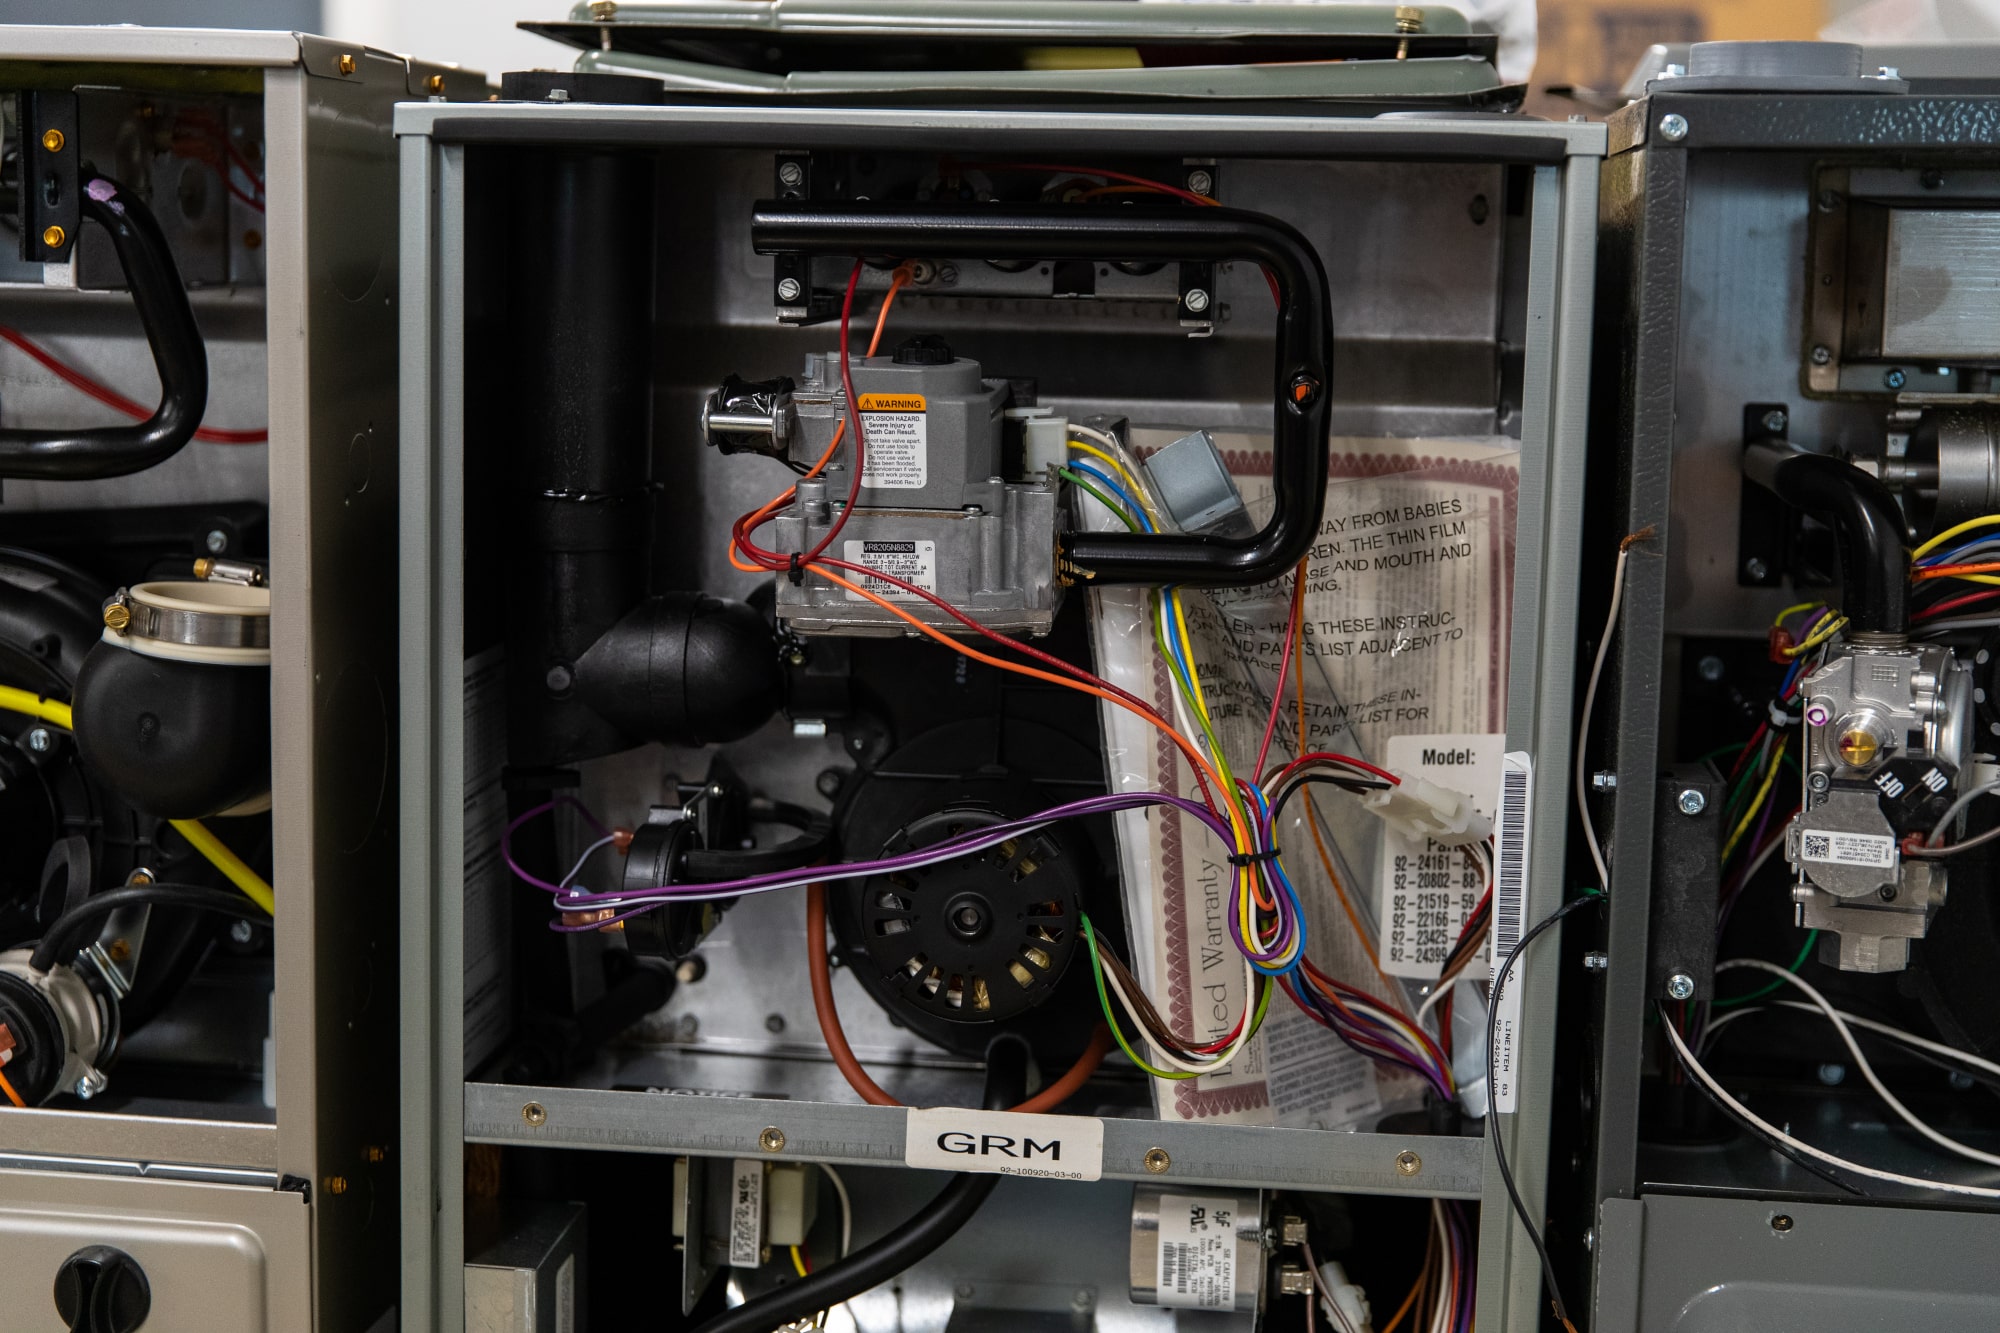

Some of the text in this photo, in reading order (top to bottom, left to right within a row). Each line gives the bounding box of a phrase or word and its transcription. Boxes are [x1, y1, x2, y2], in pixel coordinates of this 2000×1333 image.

[876, 400, 921, 408] WARNING
[1352, 510, 1400, 529] FROM
[1403, 499, 1462, 520] BABIES
[1350, 534, 1383, 552] THE
[1386, 528, 1425, 546] THIN
[1430, 521, 1466, 539] FILM
[1284, 566, 1330, 586] NSE
[1333, 560, 1369, 573] AND
[1374, 550, 1435, 570] MOUTH
[1440, 543, 1472, 561] AND
[1319, 618, 1376, 635] THESE
[1380, 612, 1456, 630] INSTRUC-
[1222, 635, 1254, 652] AND
[1320, 642, 1354, 656] LIST
[1359, 634, 1441, 654] ADJACENT
[1444, 628, 1463, 642] TO
[1401, 688, 1421, 703] IN-
[1359, 708, 1392, 724] LIST
[1396, 706, 1429, 721] FOR
[1422, 749, 1476, 765] Model:
[1874, 772, 1904, 798] OFF
[1921, 767, 1948, 793] ON
[1395, 856, 1474, 872] 92-24161-8
[1197, 858, 1224, 973] Warranty
[1392, 913, 1468, 929] 92-22166-0
[1202, 981, 1232, 1080] Lited
[937, 1132, 1061, 1161] GRM
[1000, 1166, 1082, 1179] 92-100920-03-00
